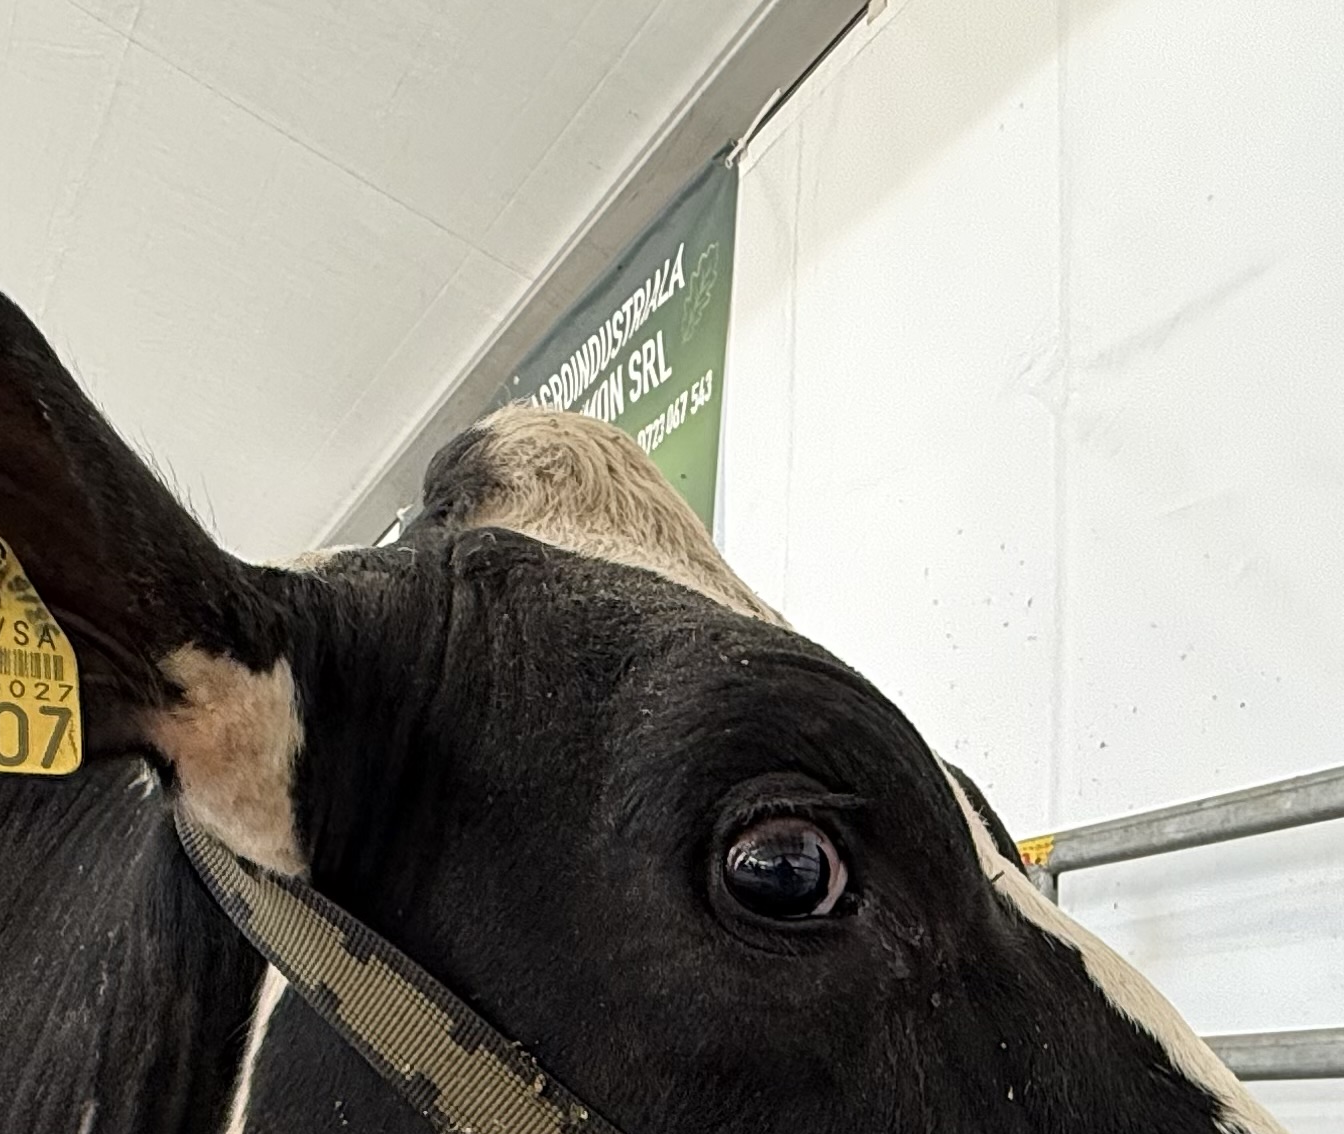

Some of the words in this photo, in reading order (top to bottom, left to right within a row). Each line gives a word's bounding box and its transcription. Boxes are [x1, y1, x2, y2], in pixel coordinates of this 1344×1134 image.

[579, 364, 624, 422] MON
[628, 330, 672, 402] SRL
[638, 412, 665, 456] 0723
[666, 390, 688, 434] 067
[690, 369, 713, 414] 543
